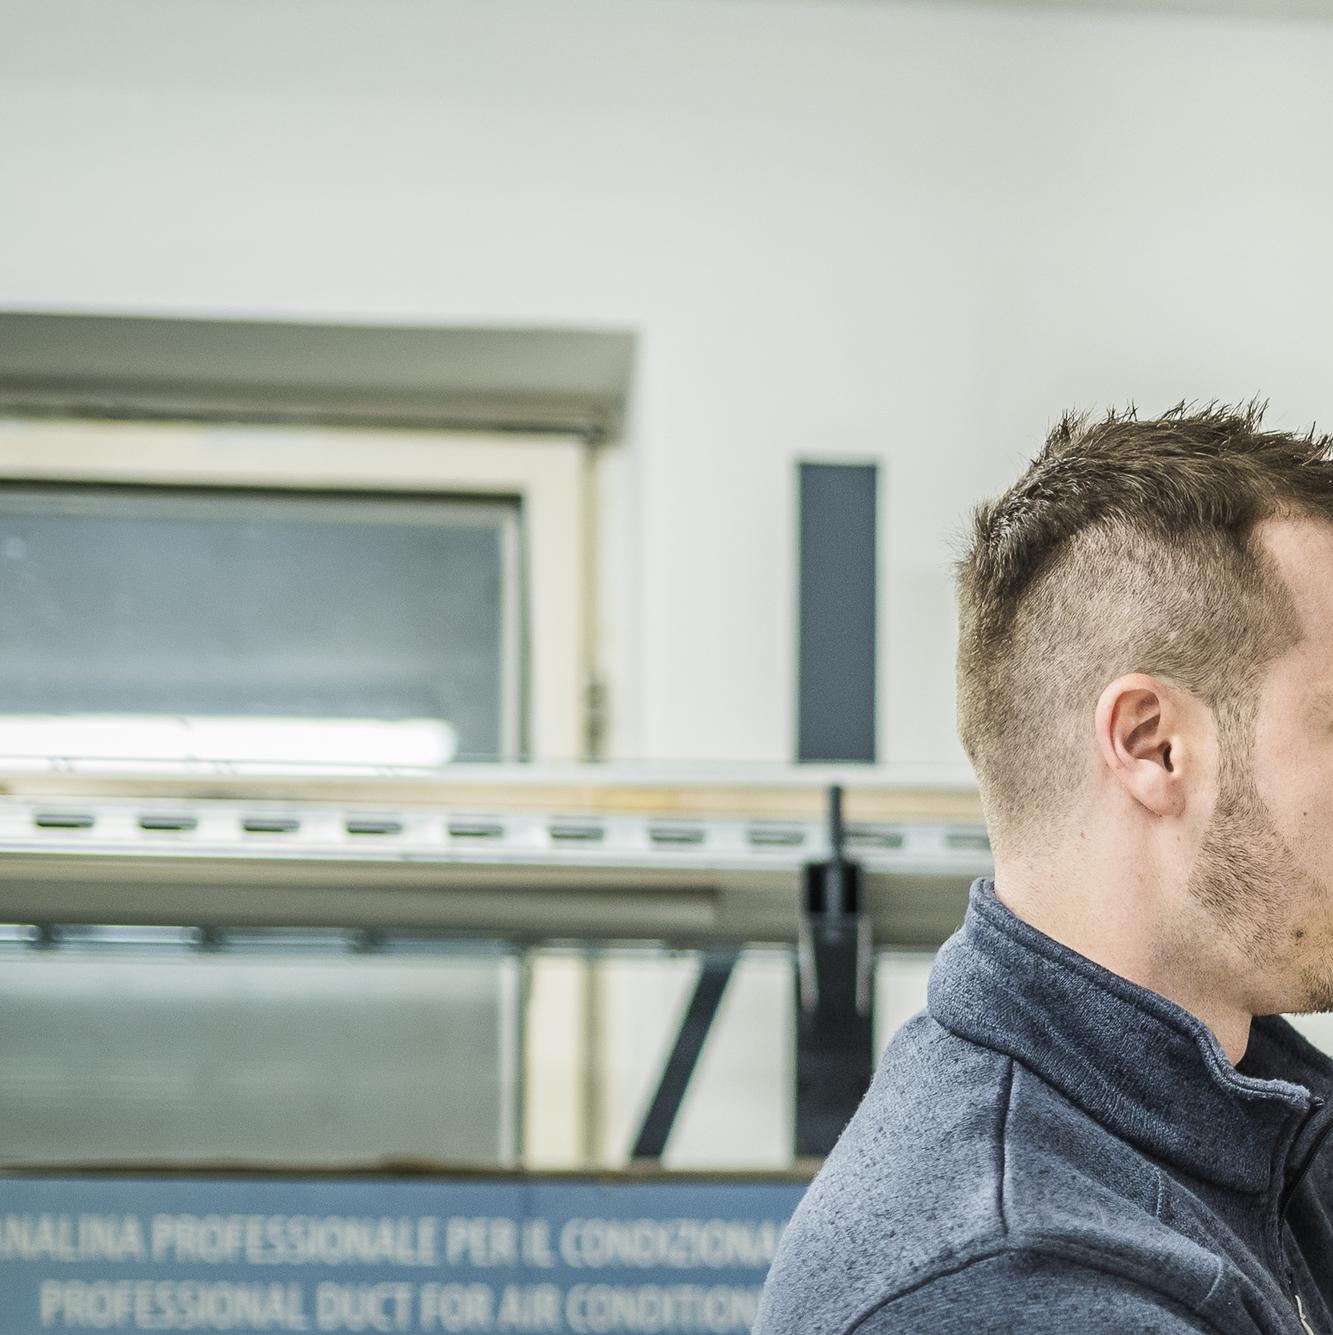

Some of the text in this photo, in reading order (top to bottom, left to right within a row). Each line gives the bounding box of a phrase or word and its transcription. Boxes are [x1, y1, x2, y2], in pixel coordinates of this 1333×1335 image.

[151, 1215, 440, 1266] PROFESSIONALE
[446, 1216, 516, 1266] PER
[523, 1217, 552, 1268] IL
[560, 1217, 785, 1268] CONDIZIONA
[41, 1280, 308, 1331] PROFESSIONAL
[317, 1281, 415, 1332] DUCT
[419, 1282, 494, 1332] FOR
[497, 1282, 561, 1332] AIR
